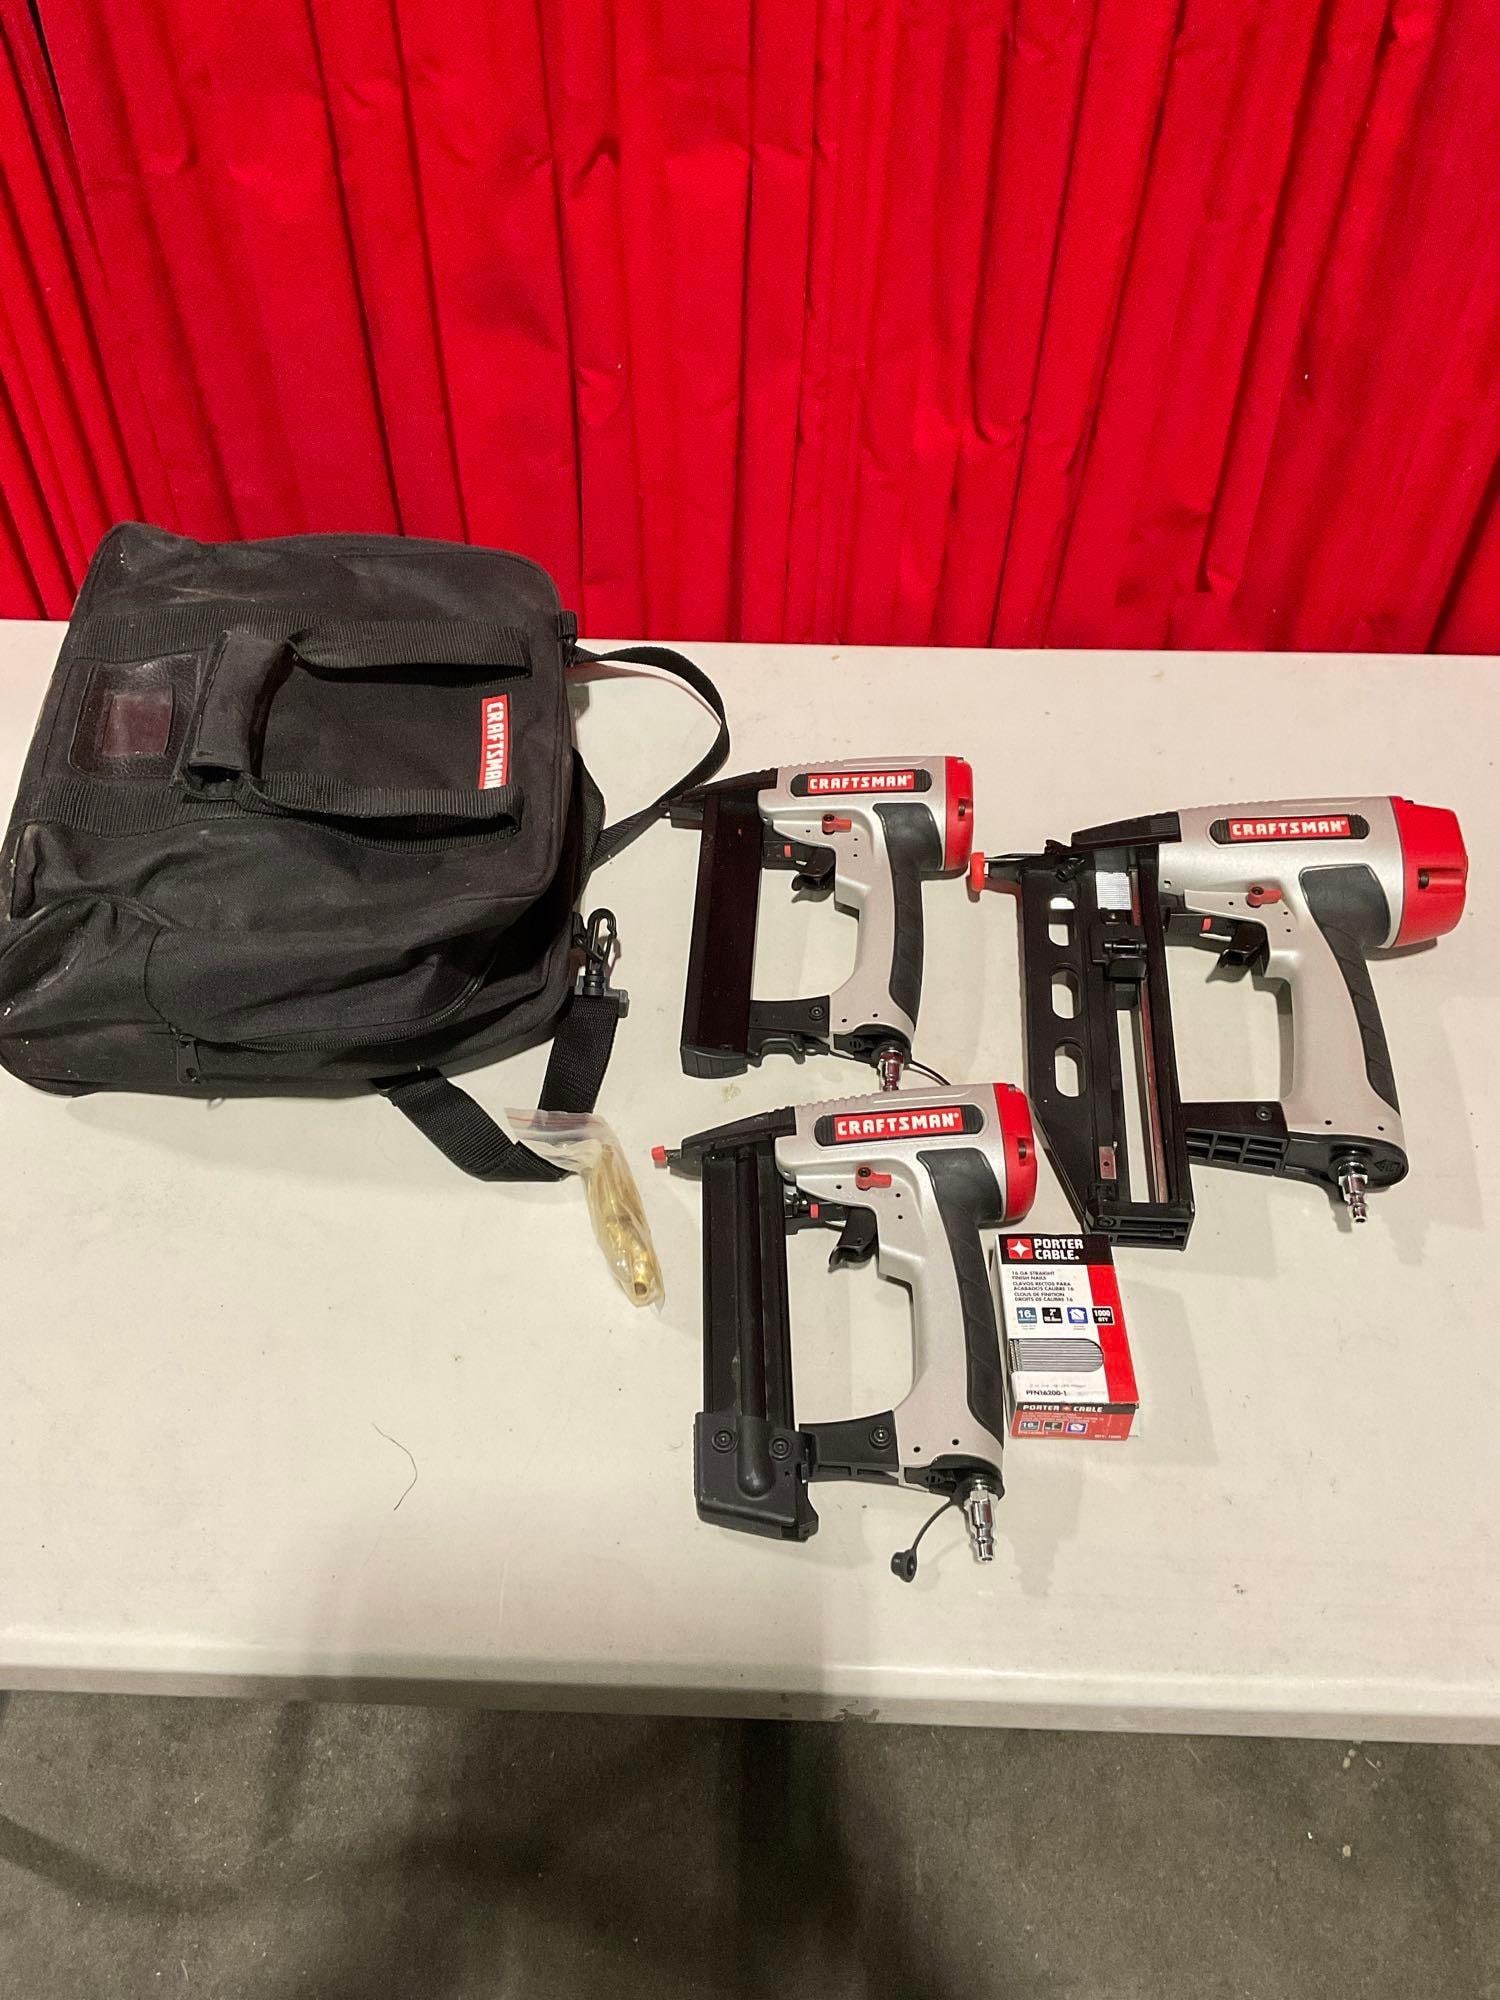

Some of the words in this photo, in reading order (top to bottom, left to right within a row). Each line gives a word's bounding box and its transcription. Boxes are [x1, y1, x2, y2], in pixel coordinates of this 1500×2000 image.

[809, 775, 908, 790] CRAFTSMAN
[1232, 821, 1342, 836] CRAFTSMAN
[837, 1112, 955, 1136] CRAFTSMAN
[1033, 1238, 1084, 1249] PORTER
